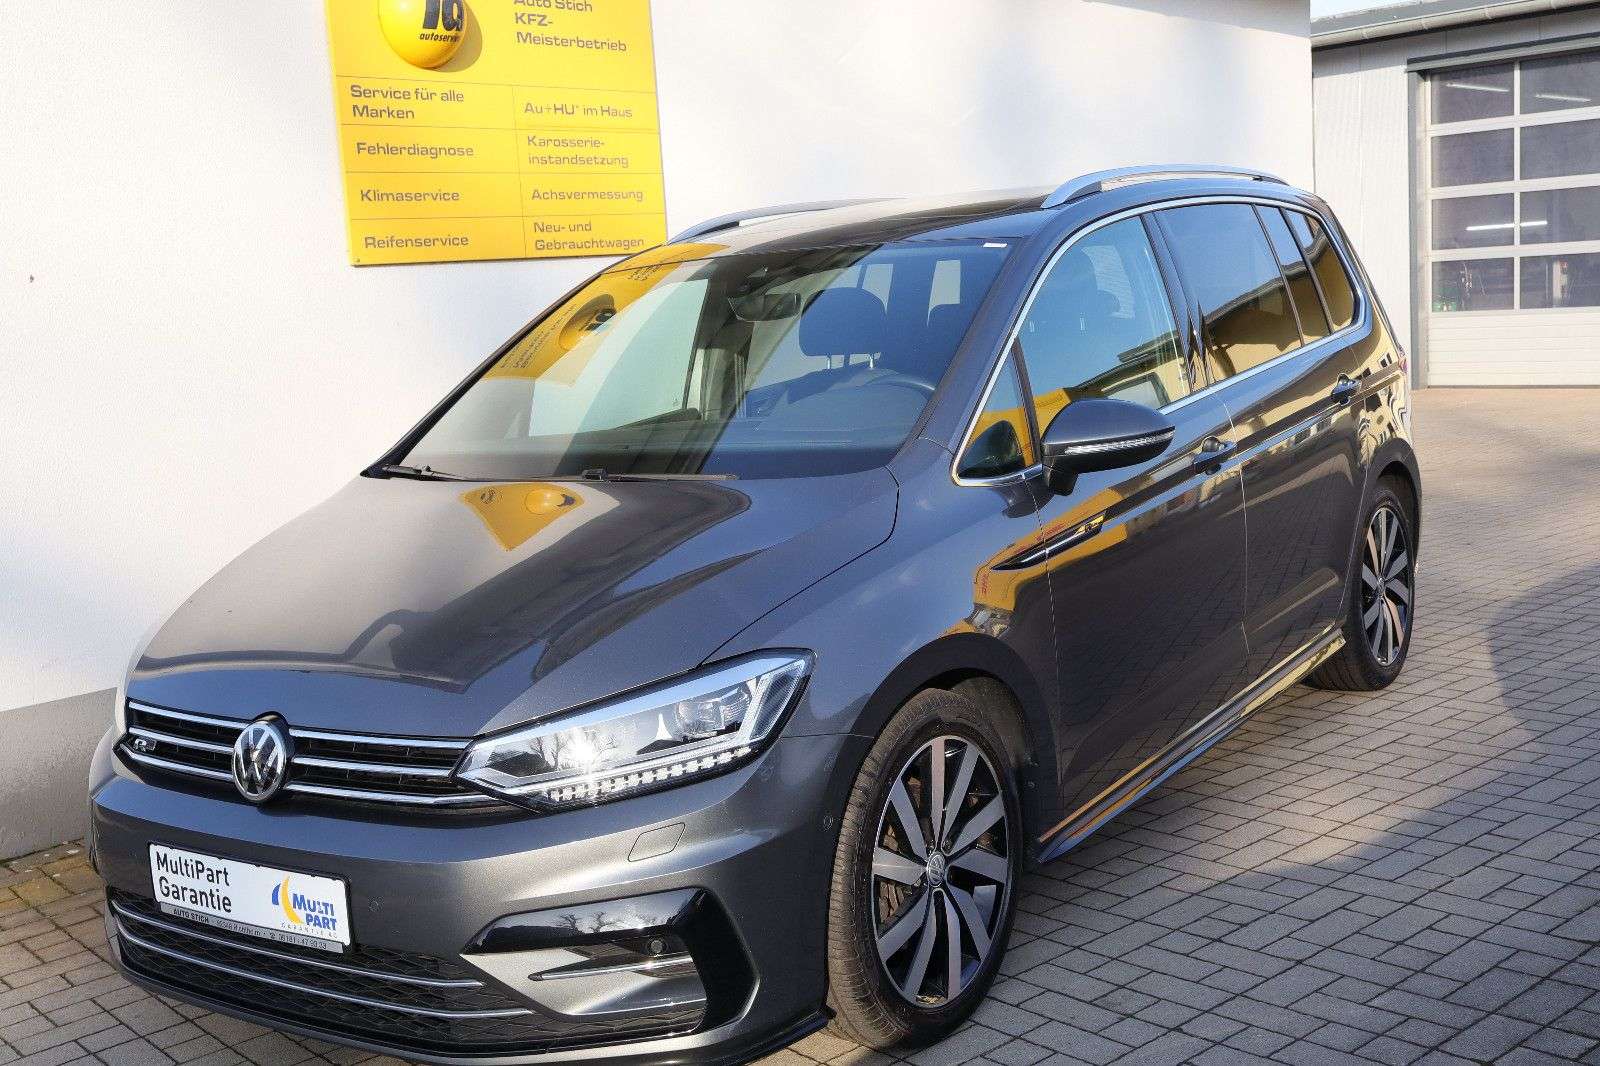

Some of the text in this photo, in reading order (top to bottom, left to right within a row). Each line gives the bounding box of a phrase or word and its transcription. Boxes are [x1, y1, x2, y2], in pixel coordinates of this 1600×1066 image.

[555, 0, 593, 12] Stich
[514, 12, 553, 27] KFZ-
[516, 31, 627, 52] Meisterbetrieb
[350, 84, 464, 103] Service für alle
[352, 104, 415, 119] Marken
[583, 107, 598, 116] im
[601, 106, 633, 118] Haus
[527, 135, 605, 148] Karosserie-
[356, 142, 474, 159] Fehlerdiagnose
[528, 153, 629, 168] instandsetzung
[360, 188, 460, 202] Klimaservice
[531, 188, 644, 202] Achsvermessung
[533, 221, 592, 233] Neu- und
[364, 234, 469, 249] Reifenservice
[535, 237, 645, 251] Gebrauchtwagen
[155, 851, 230, 887] MultiPart
[159, 875, 232, 913] Garantie
[173, 908, 209, 923] AUTO STICH
[305, 913, 337, 931] PART
